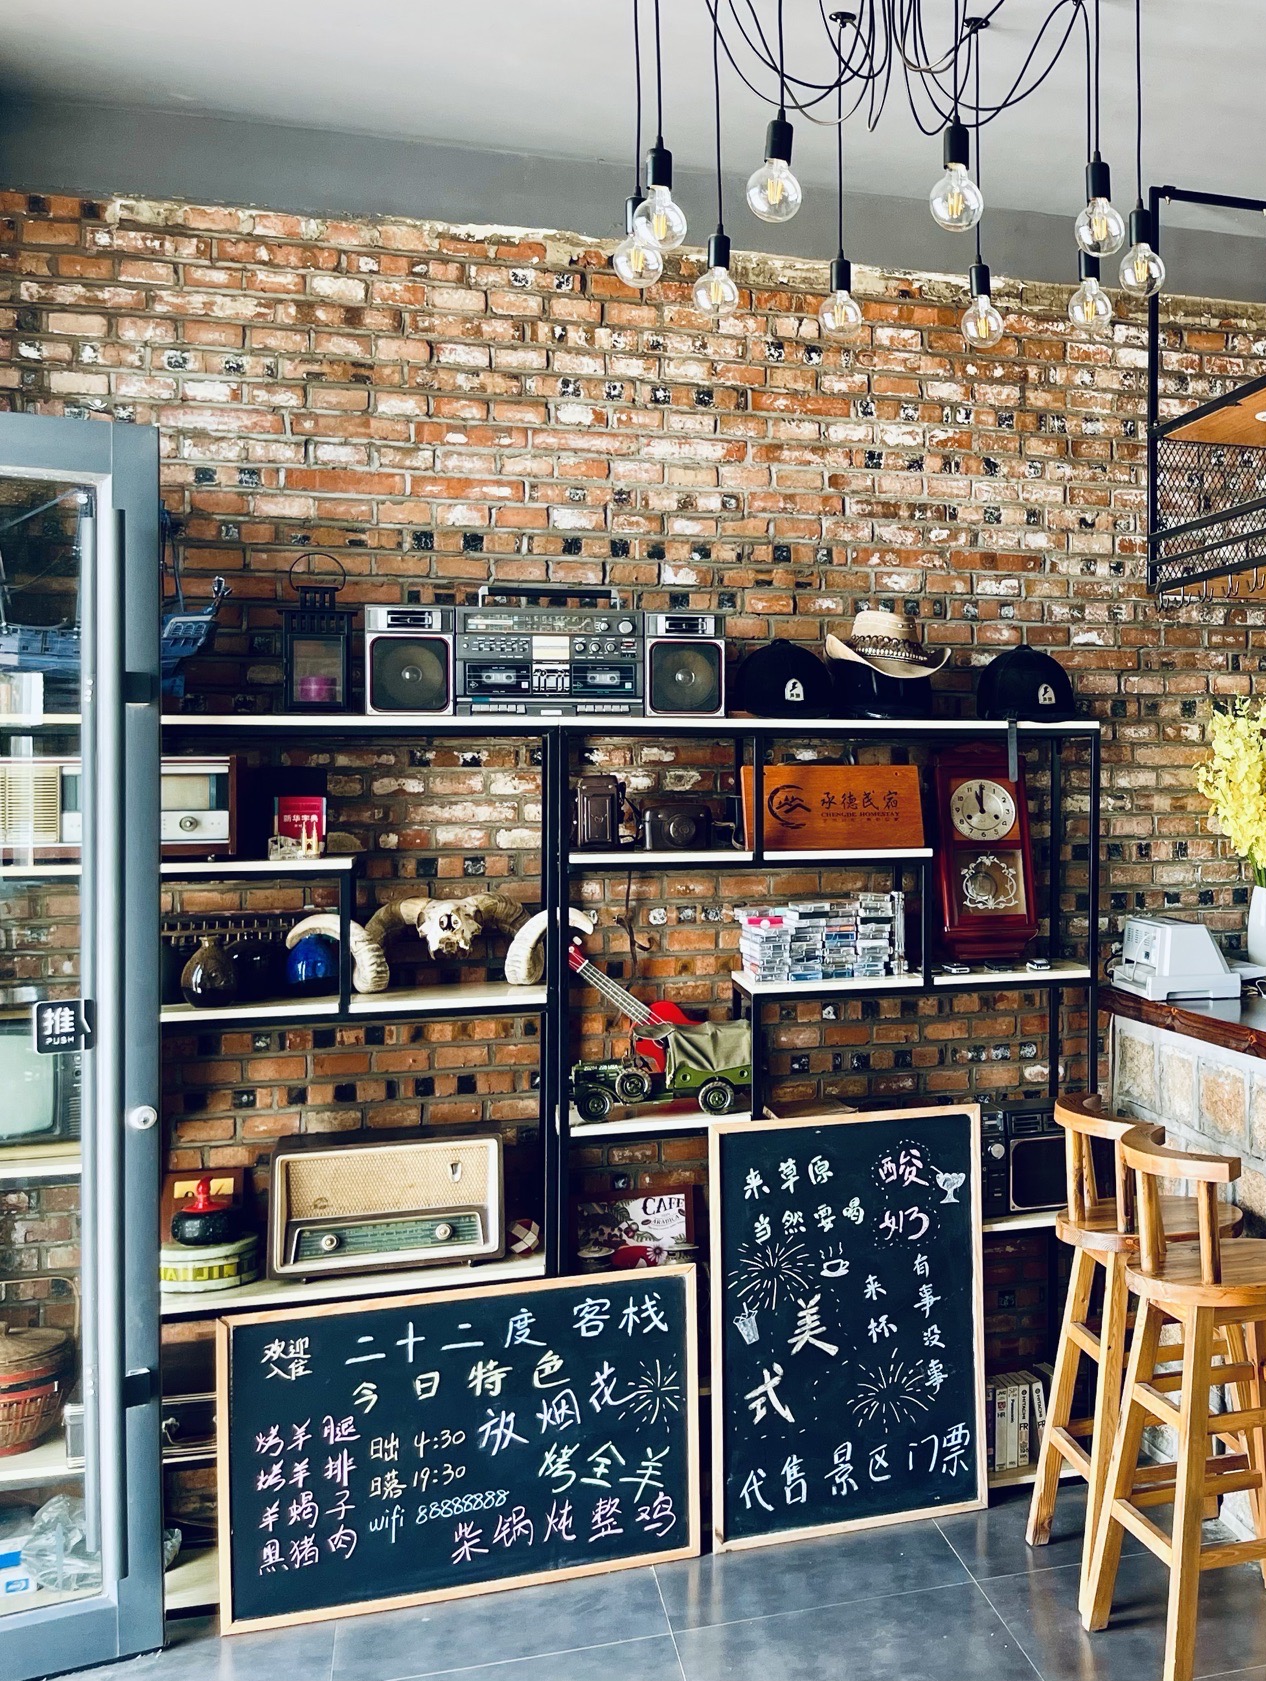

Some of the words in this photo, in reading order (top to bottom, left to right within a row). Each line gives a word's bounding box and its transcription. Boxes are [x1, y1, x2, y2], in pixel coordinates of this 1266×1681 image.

[42, 1007, 75, 1035] 推
[45, 1036, 75, 1046] PUSH
[743, 1155, 834, 1200] 来草原
[878, 1147, 930, 1241] 酸奶
[753, 1196, 865, 1245] 当然要喝
[913, 1253, 949, 1396] 有事没事
[260, 1337, 310, 1364] 欢迎
[267, 1361, 312, 1381] 入住
[352, 1350, 571, 1414] 今日特色
[478, 1361, 638, 1455] 放烟花
[255, 1414, 360, 1456] 烤羊腿
[370, 1433, 399, 1462] 日出
[414, 1430, 466, 1458] 4:30
[256, 1448, 357, 1490] 烤羊排
[370, 1468, 407, 1500] 日落
[413, 1463, 466, 1491] 19:30
[538, 1441, 670, 1504] 烤全羊
[739, 1422, 971, 1512] 代售景区门票
[259, 1490, 355, 1532] 羊蝎子
[369, 1506, 405, 1544] wifi
[450, 1491, 677, 1565] 柴锅炖整鸡
[259, 1524, 358, 1575] 黑猪肉
